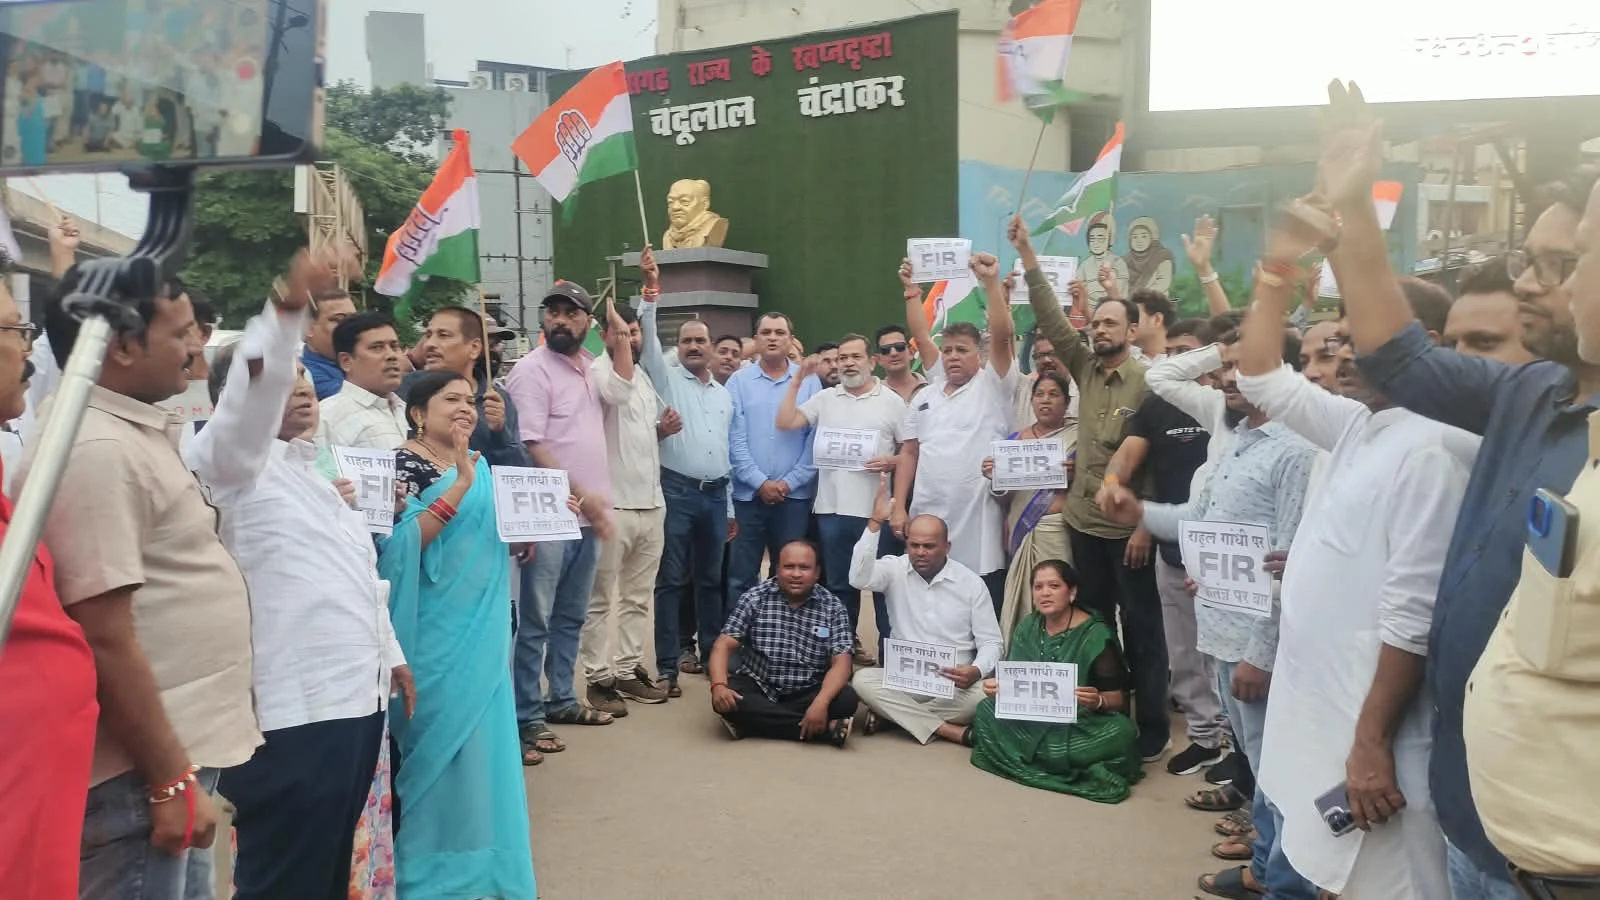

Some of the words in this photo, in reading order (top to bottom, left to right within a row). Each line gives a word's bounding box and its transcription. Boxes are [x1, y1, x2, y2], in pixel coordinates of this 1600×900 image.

[687, 58, 732, 86] राज्य
[751, 45, 772, 76] के
[649, 97, 756, 146] चंदूलाल
[797, 75, 906, 117] चंद्राकर
[920, 252, 957, 268] FIR
[827, 441, 863, 457] FIR
[344, 454, 373, 471] राहुल
[1008, 456, 1050, 473] FIR
[512, 491, 559, 514] FIR
[1188, 530, 1217, 548] राहुल
[1220, 528, 1248, 546] गांधी
[1251, 535, 1265, 549] पर
[1199, 551, 1256, 583] FIR
[900, 657, 940, 679] FIR
[1004, 667, 1027, 679] राहुल
[1030, 664, 1053, 677] गांधी
[1055, 669, 1069, 678] का
[1014, 680, 1060, 700] FIR
